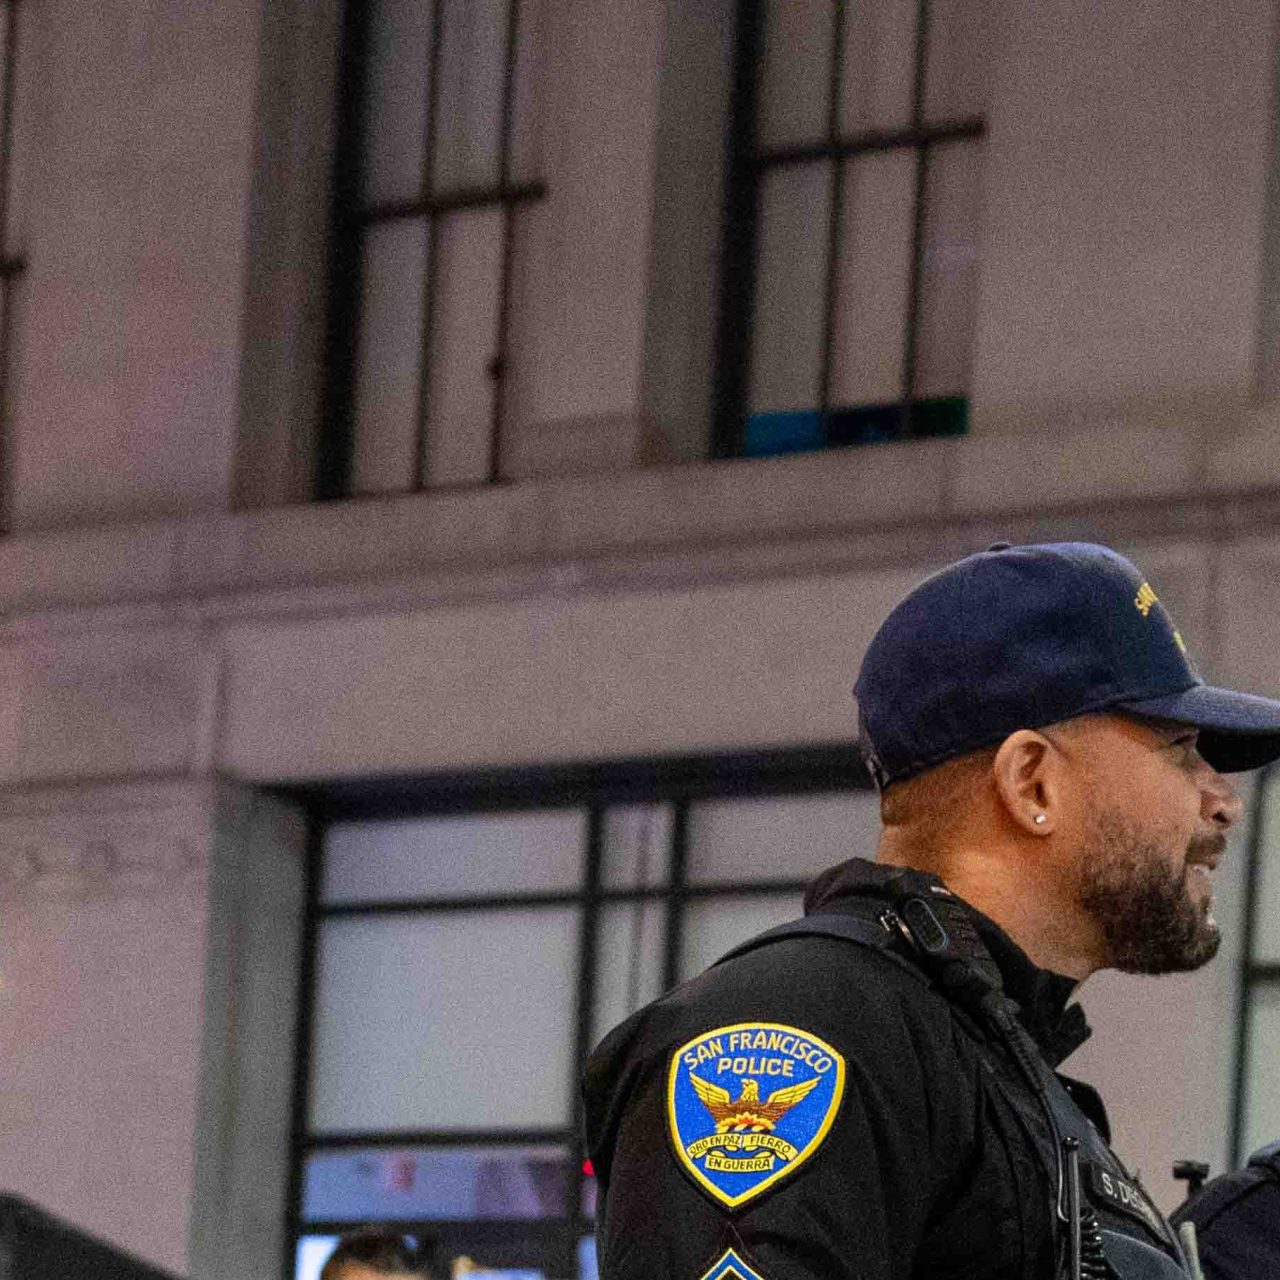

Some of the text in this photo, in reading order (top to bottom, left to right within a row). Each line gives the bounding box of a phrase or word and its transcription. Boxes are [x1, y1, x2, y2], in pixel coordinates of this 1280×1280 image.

[684, 1031, 833, 1074] SAN FRANCISCO
[716, 1057, 795, 1077] POLICE
[690, 1135, 791, 1155] ORO EN PAZ FIERRO
[708, 1158, 771, 1170] EN GUERRA
